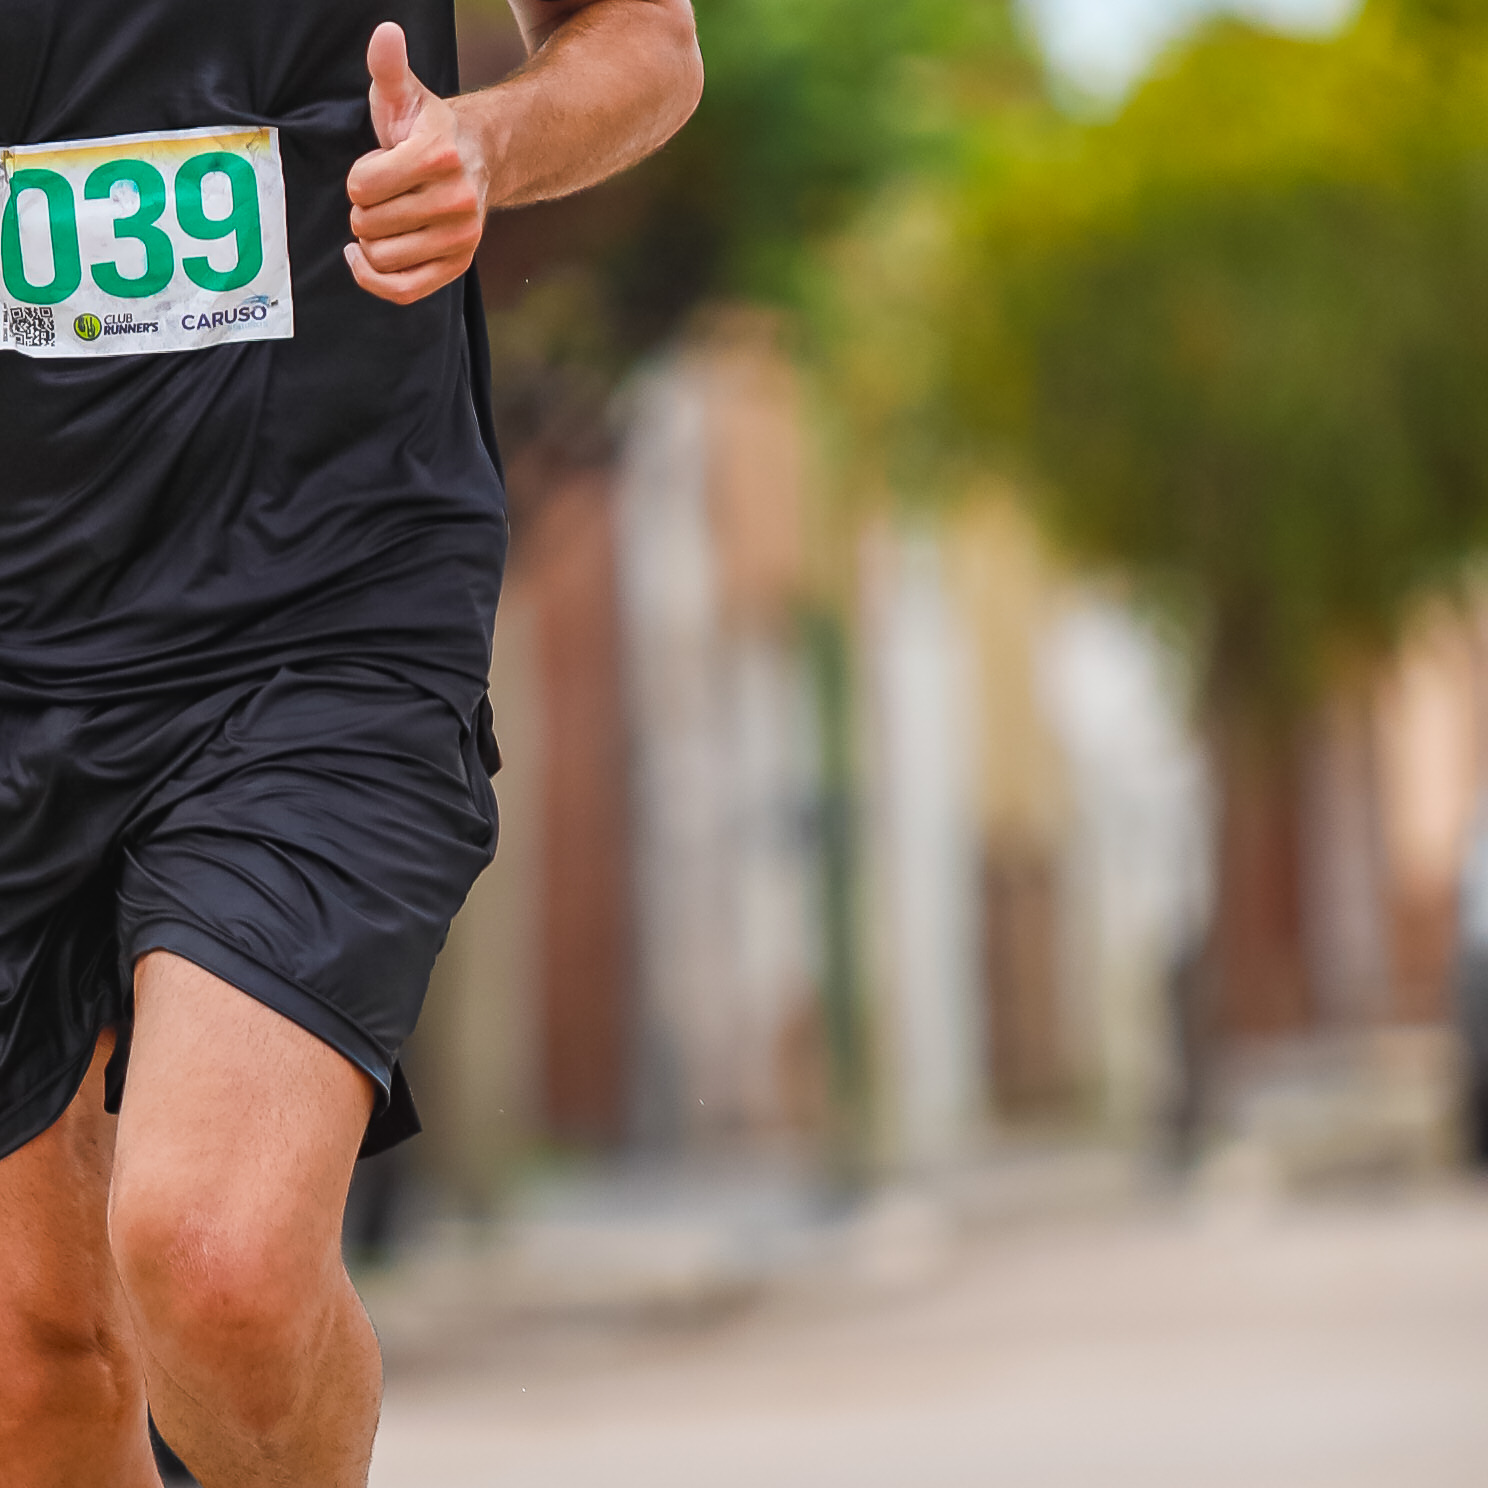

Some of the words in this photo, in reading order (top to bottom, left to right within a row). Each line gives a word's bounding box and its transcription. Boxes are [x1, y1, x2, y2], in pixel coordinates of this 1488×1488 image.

[2, 152, 262, 305] 039
[104, 313, 133, 326] CLUB
[182, 305, 266, 330] CARUSO
[104, 323, 159, 336] RUNNER'S
